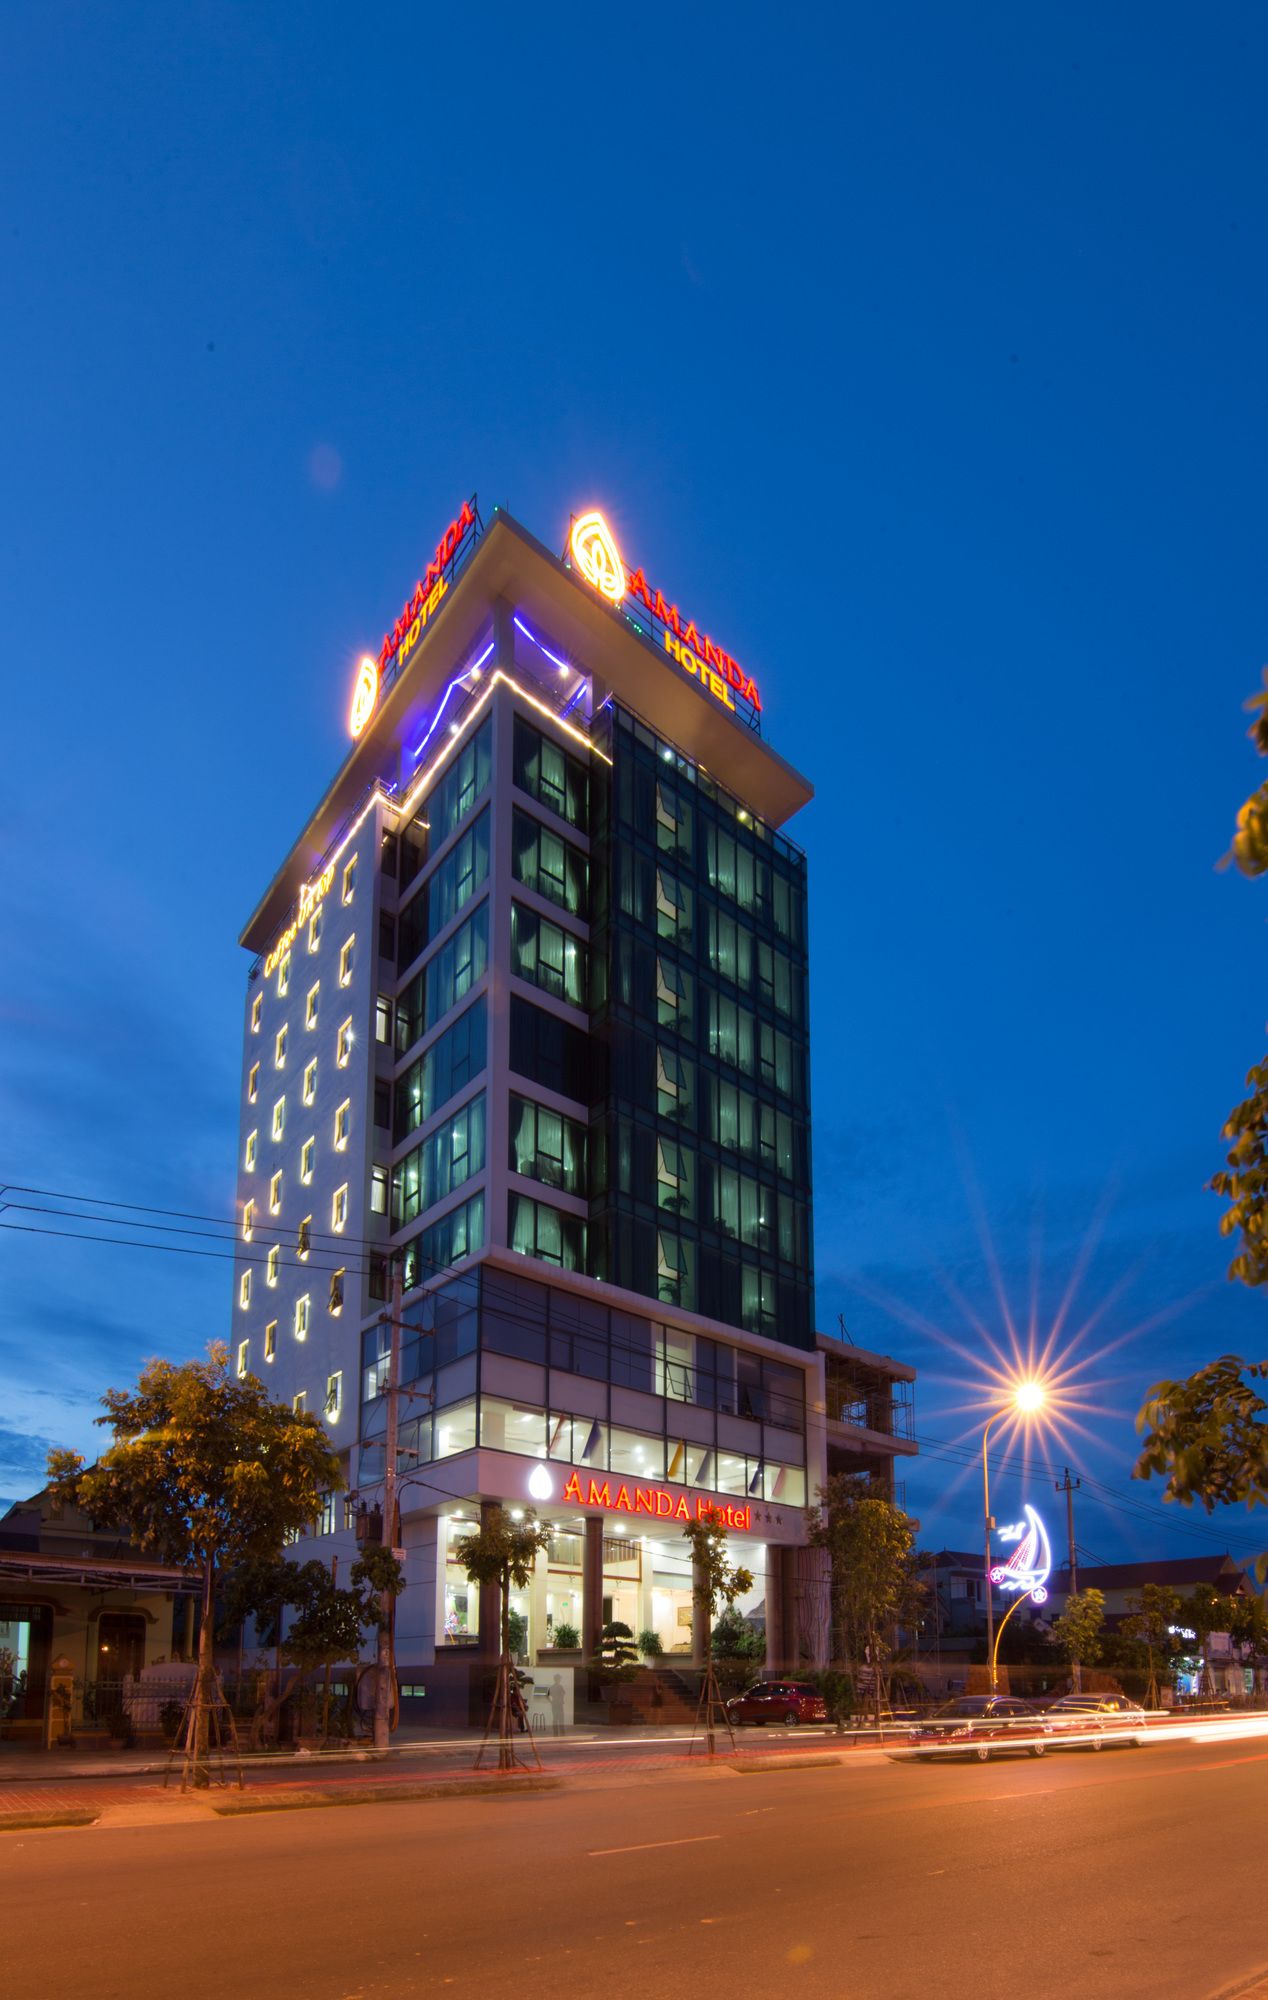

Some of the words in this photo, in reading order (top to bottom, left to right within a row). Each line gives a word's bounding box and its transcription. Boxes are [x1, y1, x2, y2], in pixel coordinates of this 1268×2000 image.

[378, 501, 475, 673] AMANDA
[399, 575, 449, 666] HOTEL
[628, 568, 762, 712] AMANDA
[664, 630, 736, 712] HOTEL
[563, 1471, 692, 1521] AMANDA
[696, 1496, 751, 1529] Hotel
